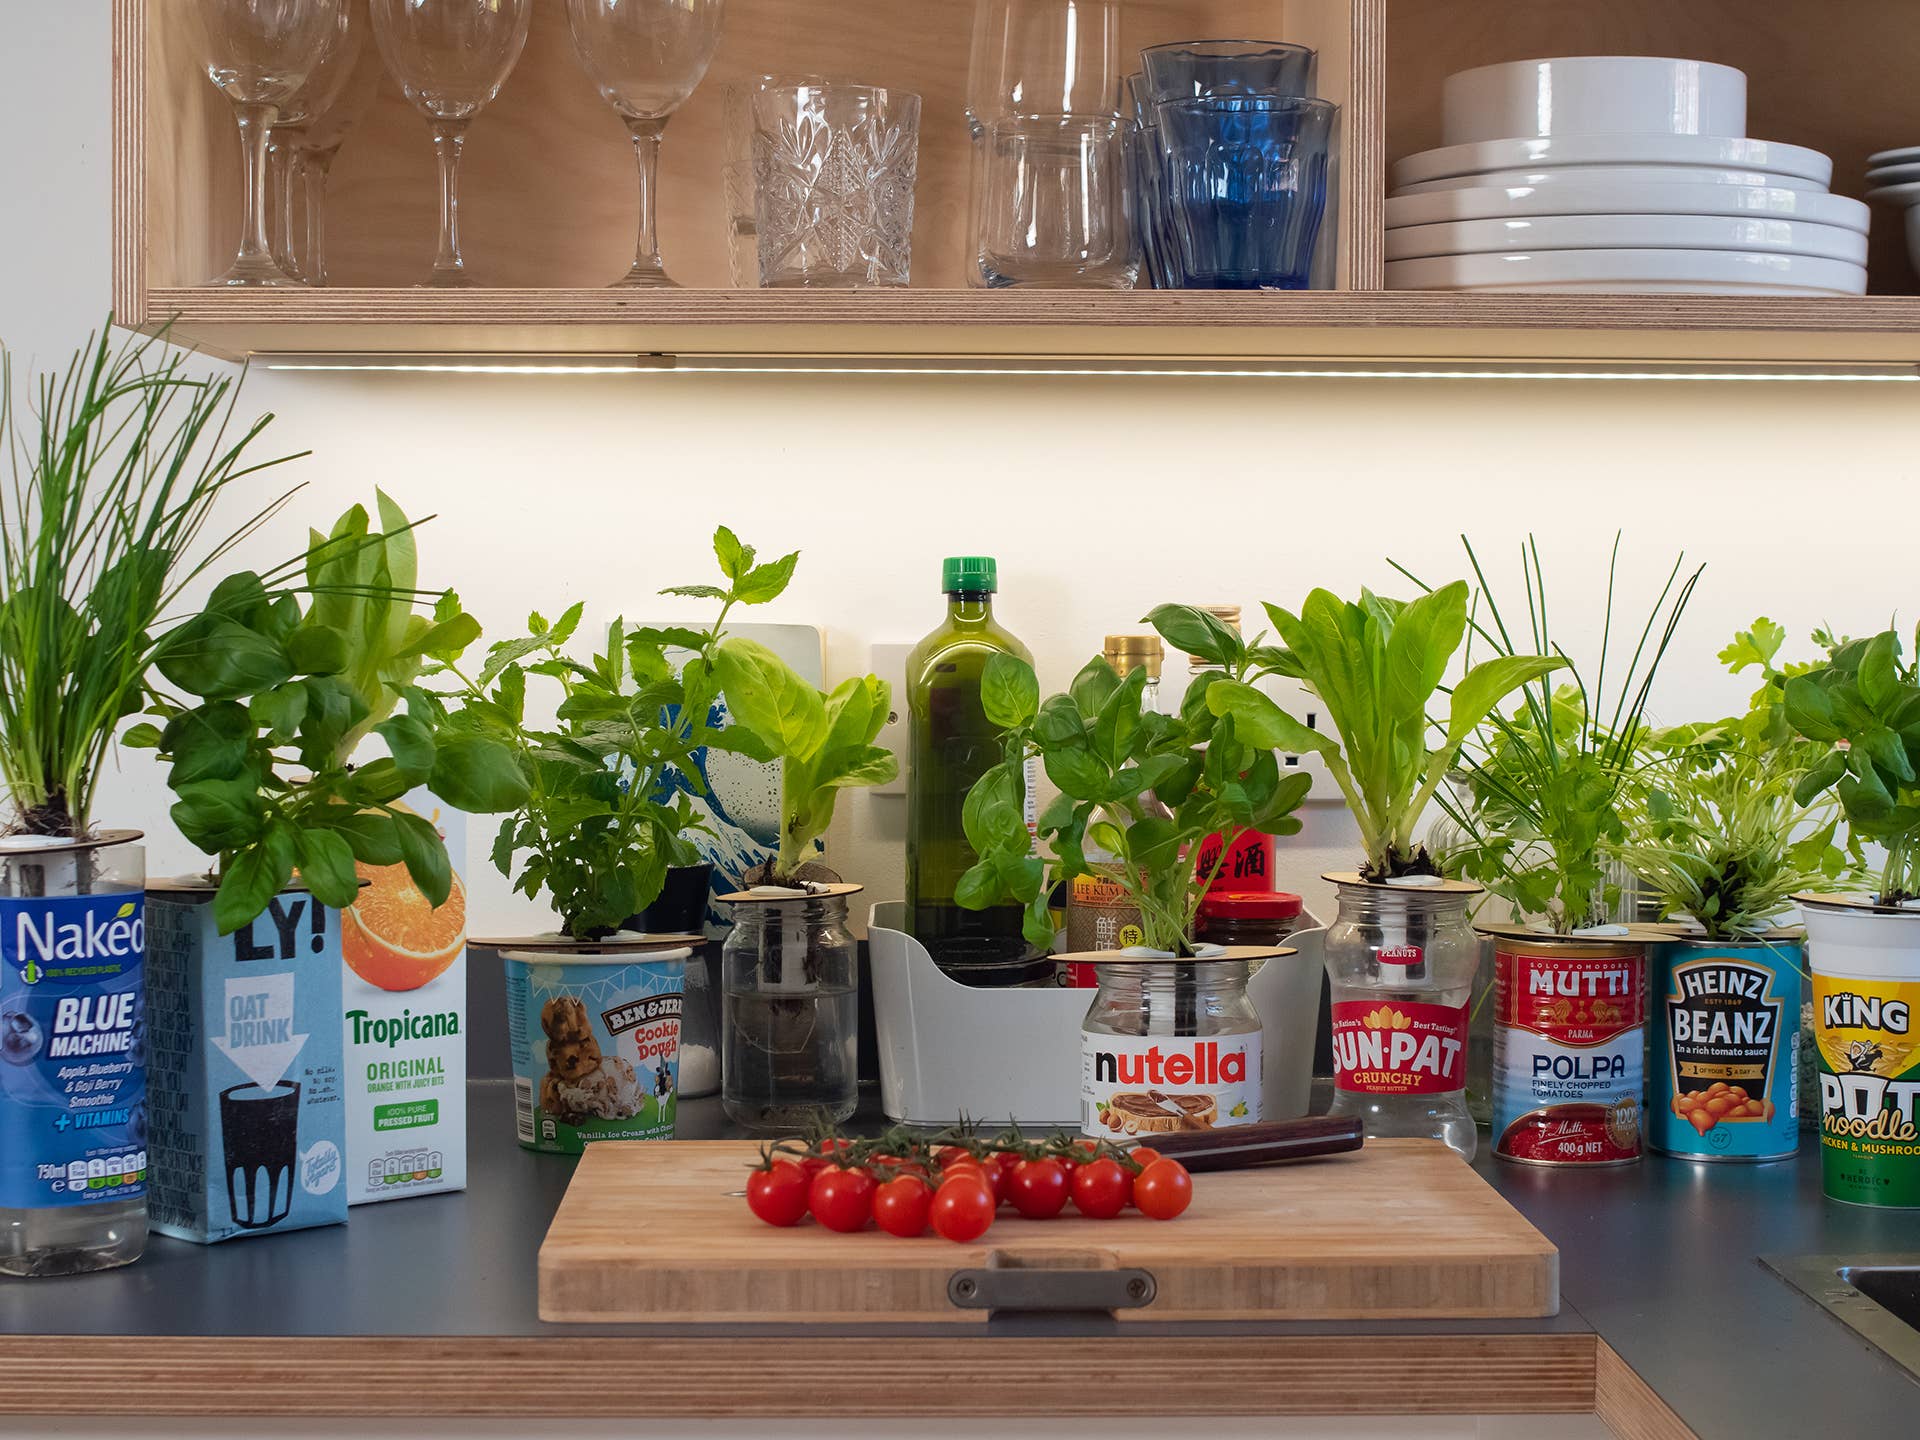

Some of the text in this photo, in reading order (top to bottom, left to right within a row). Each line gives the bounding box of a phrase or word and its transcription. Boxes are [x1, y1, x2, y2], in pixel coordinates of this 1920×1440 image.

[1076, 883, 1090, 895] LEE
[1093, 884, 1119, 897] KUM
[16, 904, 145, 962] Naked
[1122, 928, 1139, 945] 特
[1381, 948, 1418, 958] PEANUTS
[1529, 961, 1629, 970] SOLO POMODORO
[1529, 969, 1629, 997] MUTTI
[1684, 970, 1763, 1000] HEINZ
[54, 992, 136, 1034] BLUE
[229, 992, 270, 1022] OAT
[609, 1004, 647, 1030] BEN
[647, 1002, 659, 1017] &
[230, 1017, 290, 1049] DRINK
[345, 1008, 459, 1049] Tropicana
[634, 1020, 679, 1044] Cookie
[1413, 1021, 1430, 1030] Best
[1567, 1028, 1594, 1039] PARMA
[1674, 1008, 1772, 1044] BEANZ
[49, 1030, 133, 1057] MACHINE
[637, 1037, 677, 1060] Dough
[1676, 1043, 1768, 1056] In a rich tomato sauce
[87, 1062, 135, 1077] Blueberry
[366, 1056, 445, 1081] ORIGINAL
[1095, 1041, 1246, 1085] nutella
[1532, 1054, 1625, 1080] POLPA
[1693, 1065, 1699, 1075] 1
[1725, 1066, 1733, 1077] 5
[64, 1078, 124, 1093] & Goji Berry
[367, 1075, 445, 1093] ORANGE WITH JUICY BITS
[1353, 1071, 1423, 1087] CRUNCHY
[1532, 1079, 1612, 1090] FINELY CHOPPED
[69, 1093, 115, 1108] Smoothie
[1532, 1088, 1584, 1098] TOMATOES
[1819, 1072, 1920, 1123] POT
[75, 1108, 129, 1129] VITAMINS
[387, 1104, 427, 1117] 100% PURE
[378, 1112, 435, 1128] PRESSED FRUIT
[1548, 1120, 1583, 1137] Mutti
[1822, 1108, 1919, 1142] noodle
[576, 1131, 606, 1139] Vanilla
[607, 1131, 620, 1139] Ice
[621, 1129, 645, 1138] Cream
[646, 1126, 660, 1135] with
[1712, 1132, 1728, 1144] 57
[1558, 1141, 1602, 1156] 400 g NET
[1850, 1141, 1859, 1152] &
[37, 1162, 67, 1180] 750ml
